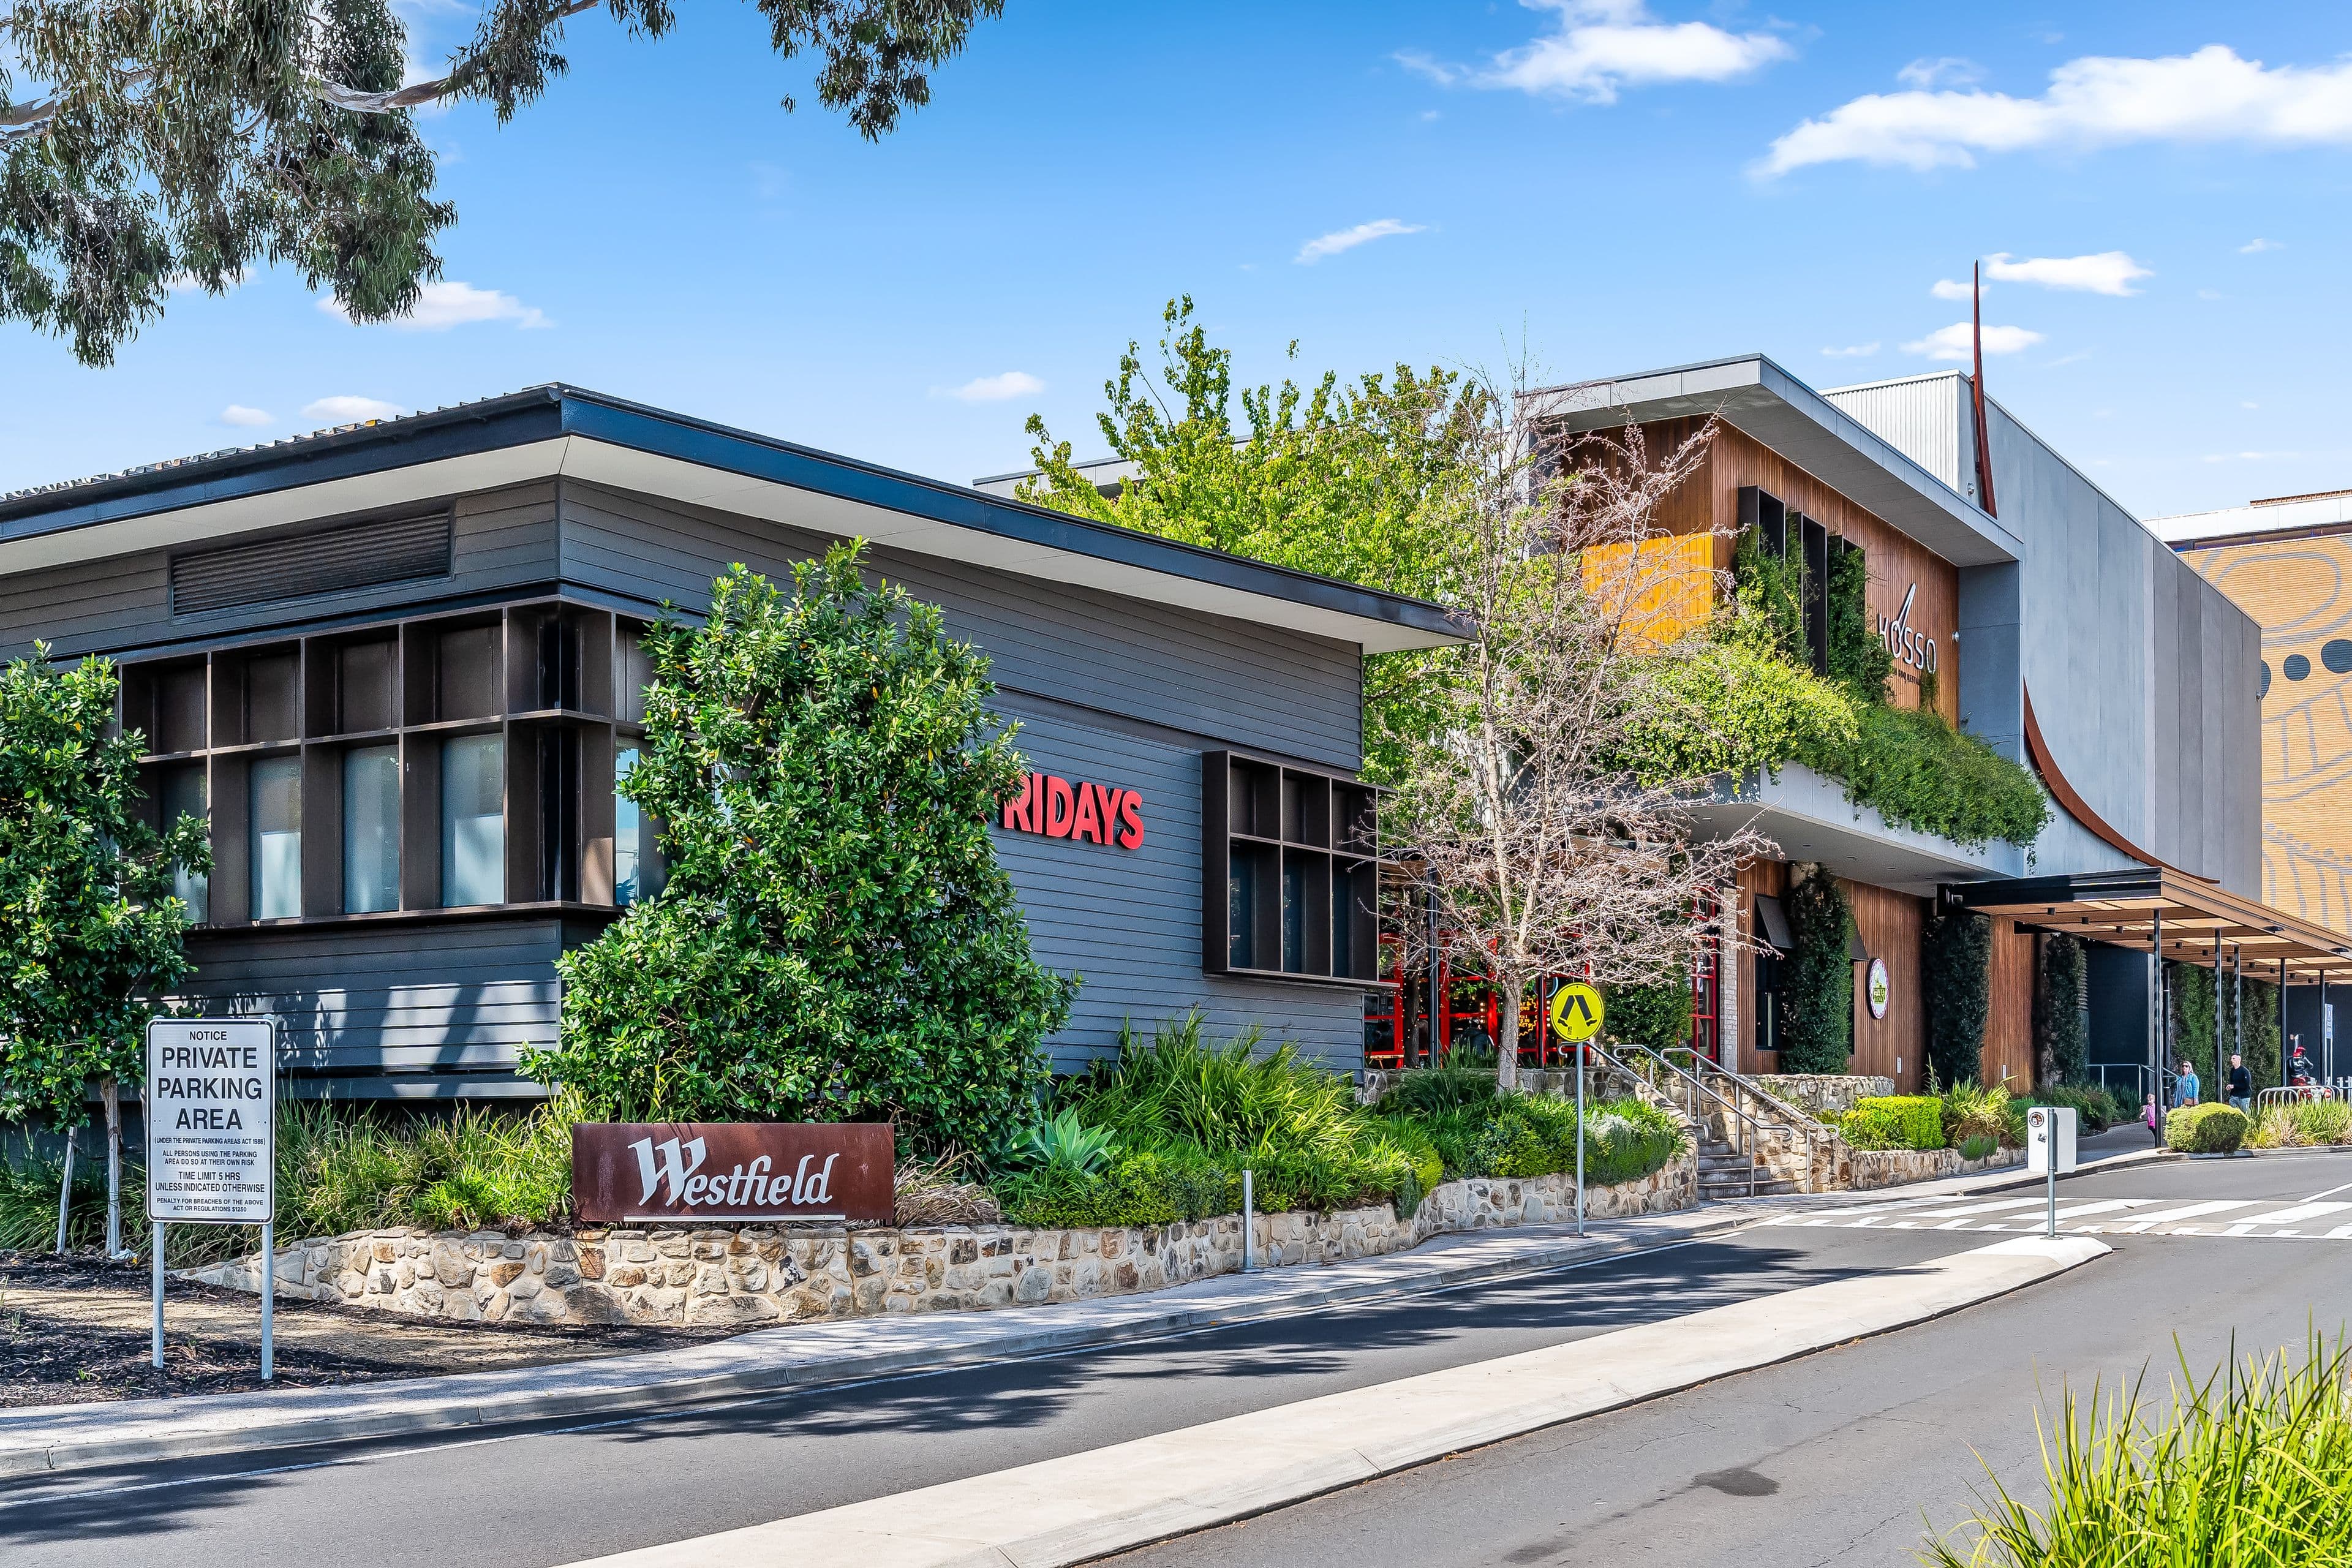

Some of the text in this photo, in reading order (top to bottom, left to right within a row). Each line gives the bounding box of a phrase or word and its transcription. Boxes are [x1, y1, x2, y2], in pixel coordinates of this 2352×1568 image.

[993, 772, 1144, 850] RIDAYS
[189, 1031, 227, 1040] NOTICE
[162, 1047, 257, 1068] PRIVATE
[157, 1077, 262, 1099] PARKING
[176, 1109, 243, 1129] AREA
[179, 1171, 195, 1180] TIME
[627, 1136, 840, 1207] Westfield
[156, 1182, 265, 1193] UNLESS INDICATED OTHERWISE
